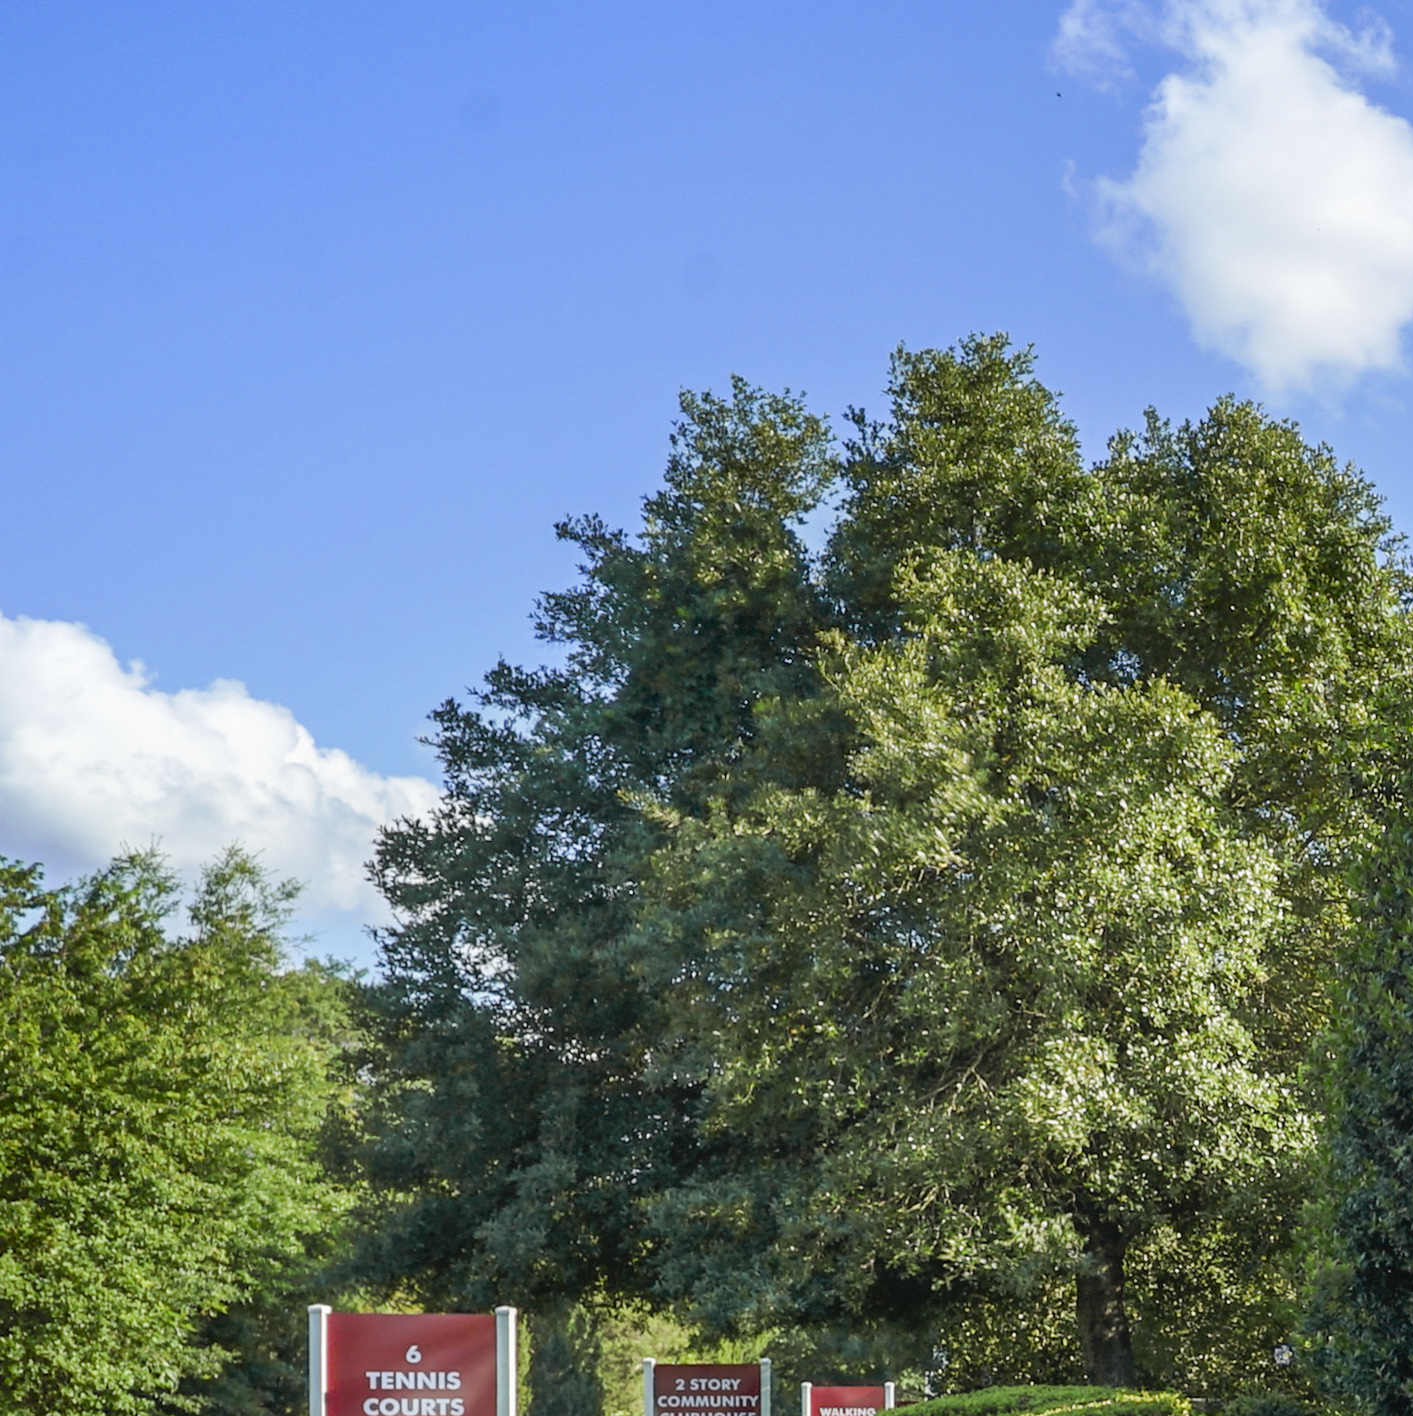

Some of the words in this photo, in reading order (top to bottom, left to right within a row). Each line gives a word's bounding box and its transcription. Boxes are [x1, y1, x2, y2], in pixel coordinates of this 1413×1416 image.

[405, 1344, 422, 1364] 6
[365, 1371, 462, 1390] TENNIS
[675, 1378, 686, 1391] 2
[690, 1378, 742, 1391] STORY
[363, 1398, 466, 1416] COURTS
[657, 1395, 759, 1408] COMMUNITY
